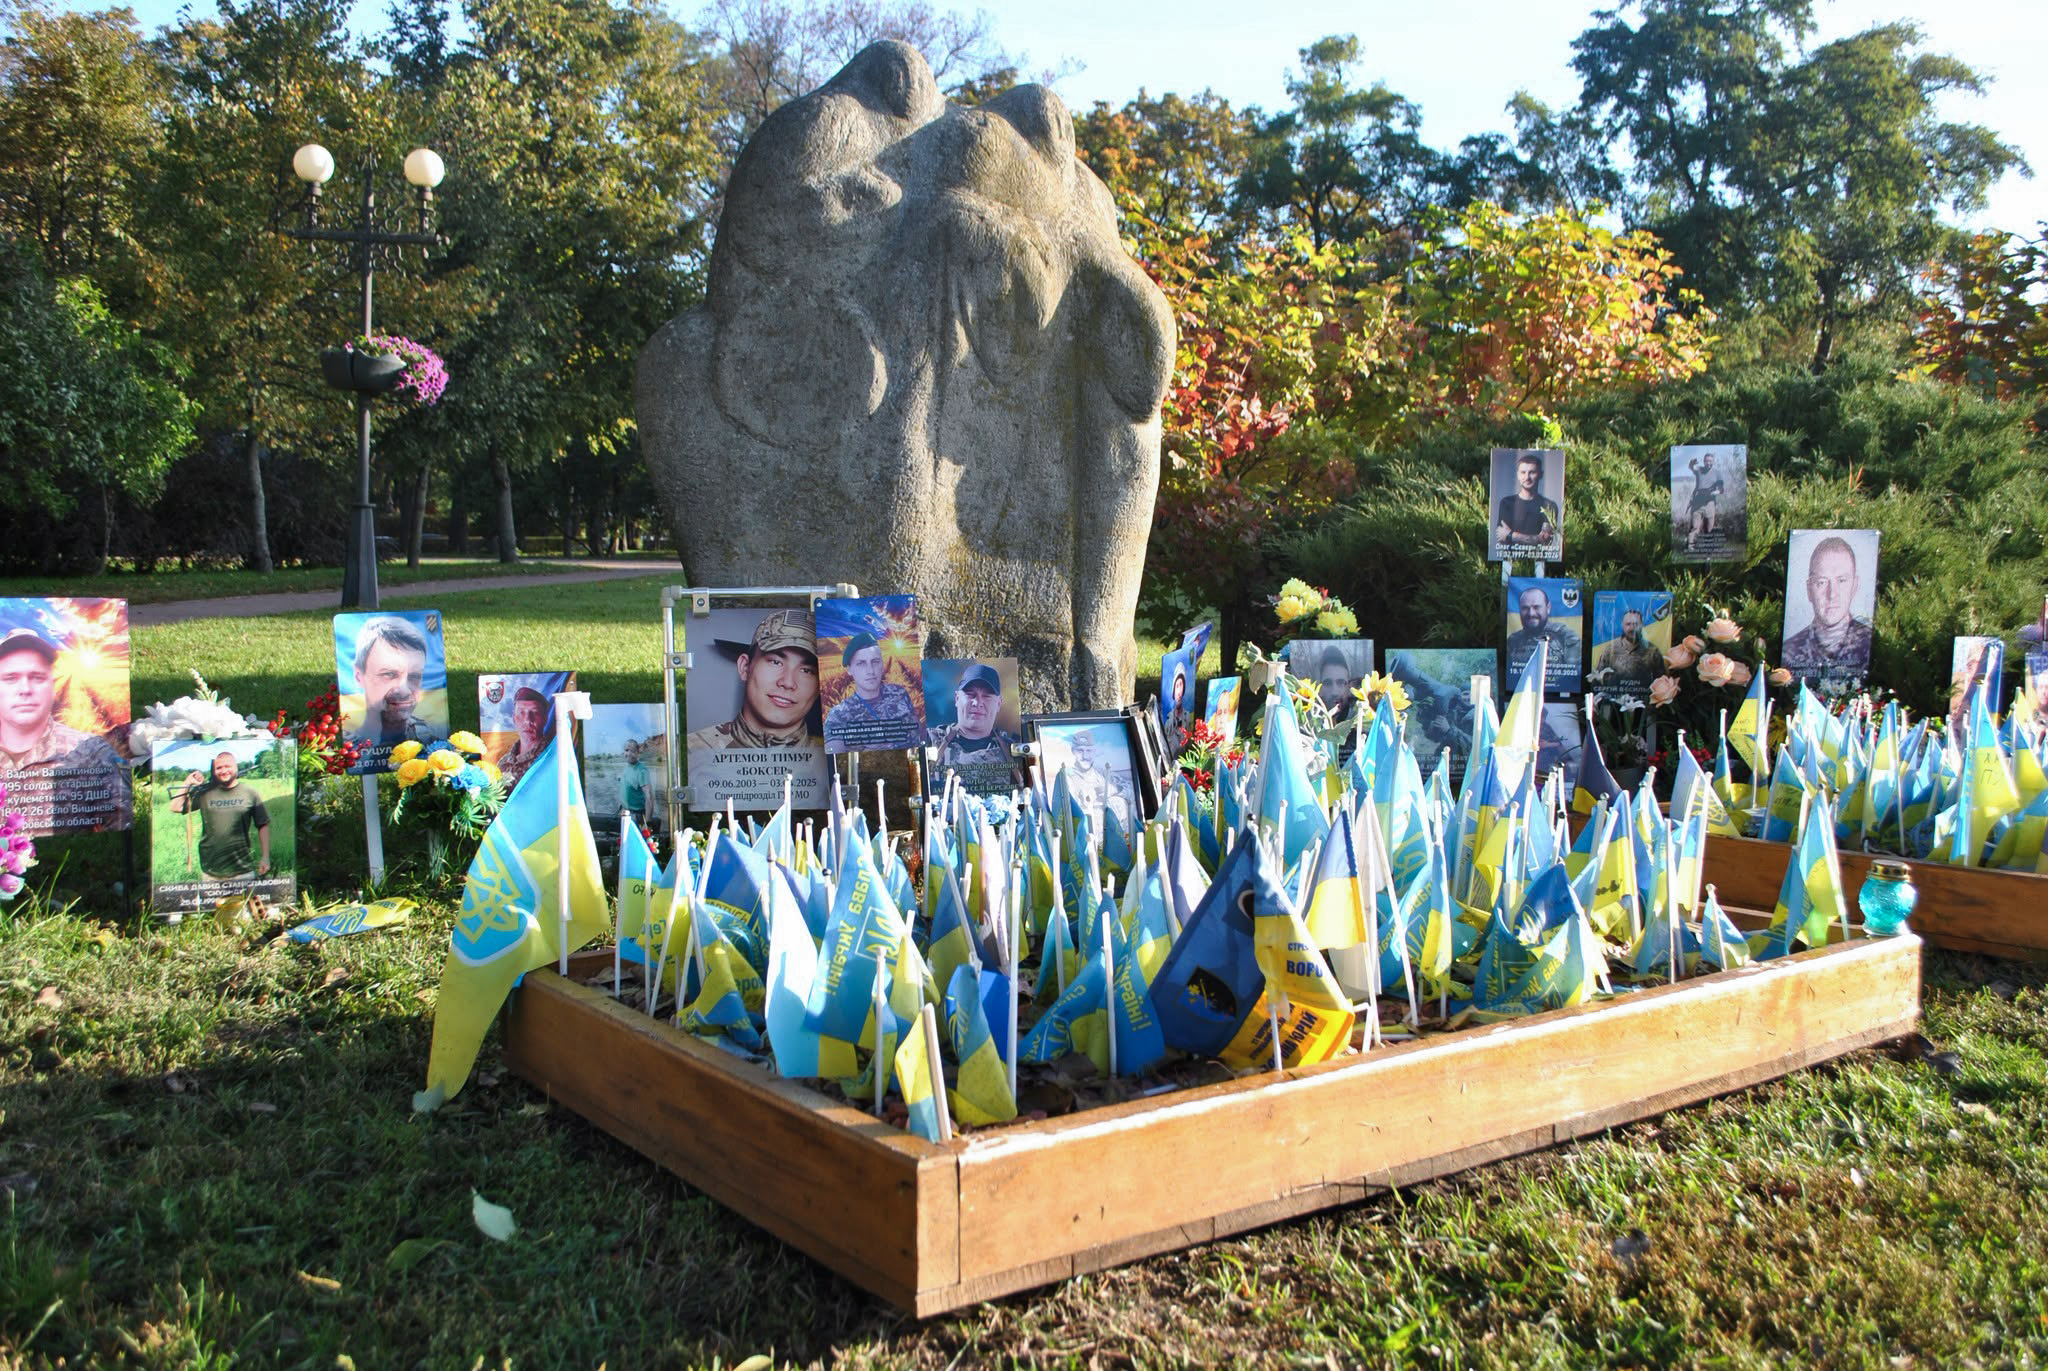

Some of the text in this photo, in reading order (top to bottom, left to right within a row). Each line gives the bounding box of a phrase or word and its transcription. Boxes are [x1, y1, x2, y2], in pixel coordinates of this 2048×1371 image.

[713, 752, 812, 763] АРТЕМОВ ТИМУР
[6, 767, 113, 779] Вадим Валентинович
[23, 781, 57, 791] солдат
[60, 779, 103, 790] старший
[708, 779, 757, 789] 09.06.2003
[770, 778, 817, 788] 03..2025
[71, 791, 84, 801] 95
[86, 790, 110, 800] ДШВ
[714, 792, 776, 801] Спецпідрозділ
[795, 790, 809, 799] МО
[46, 806, 69, 815] село
[72, 803, 115, 813] Вишневе
[67, 817, 102, 826] області
